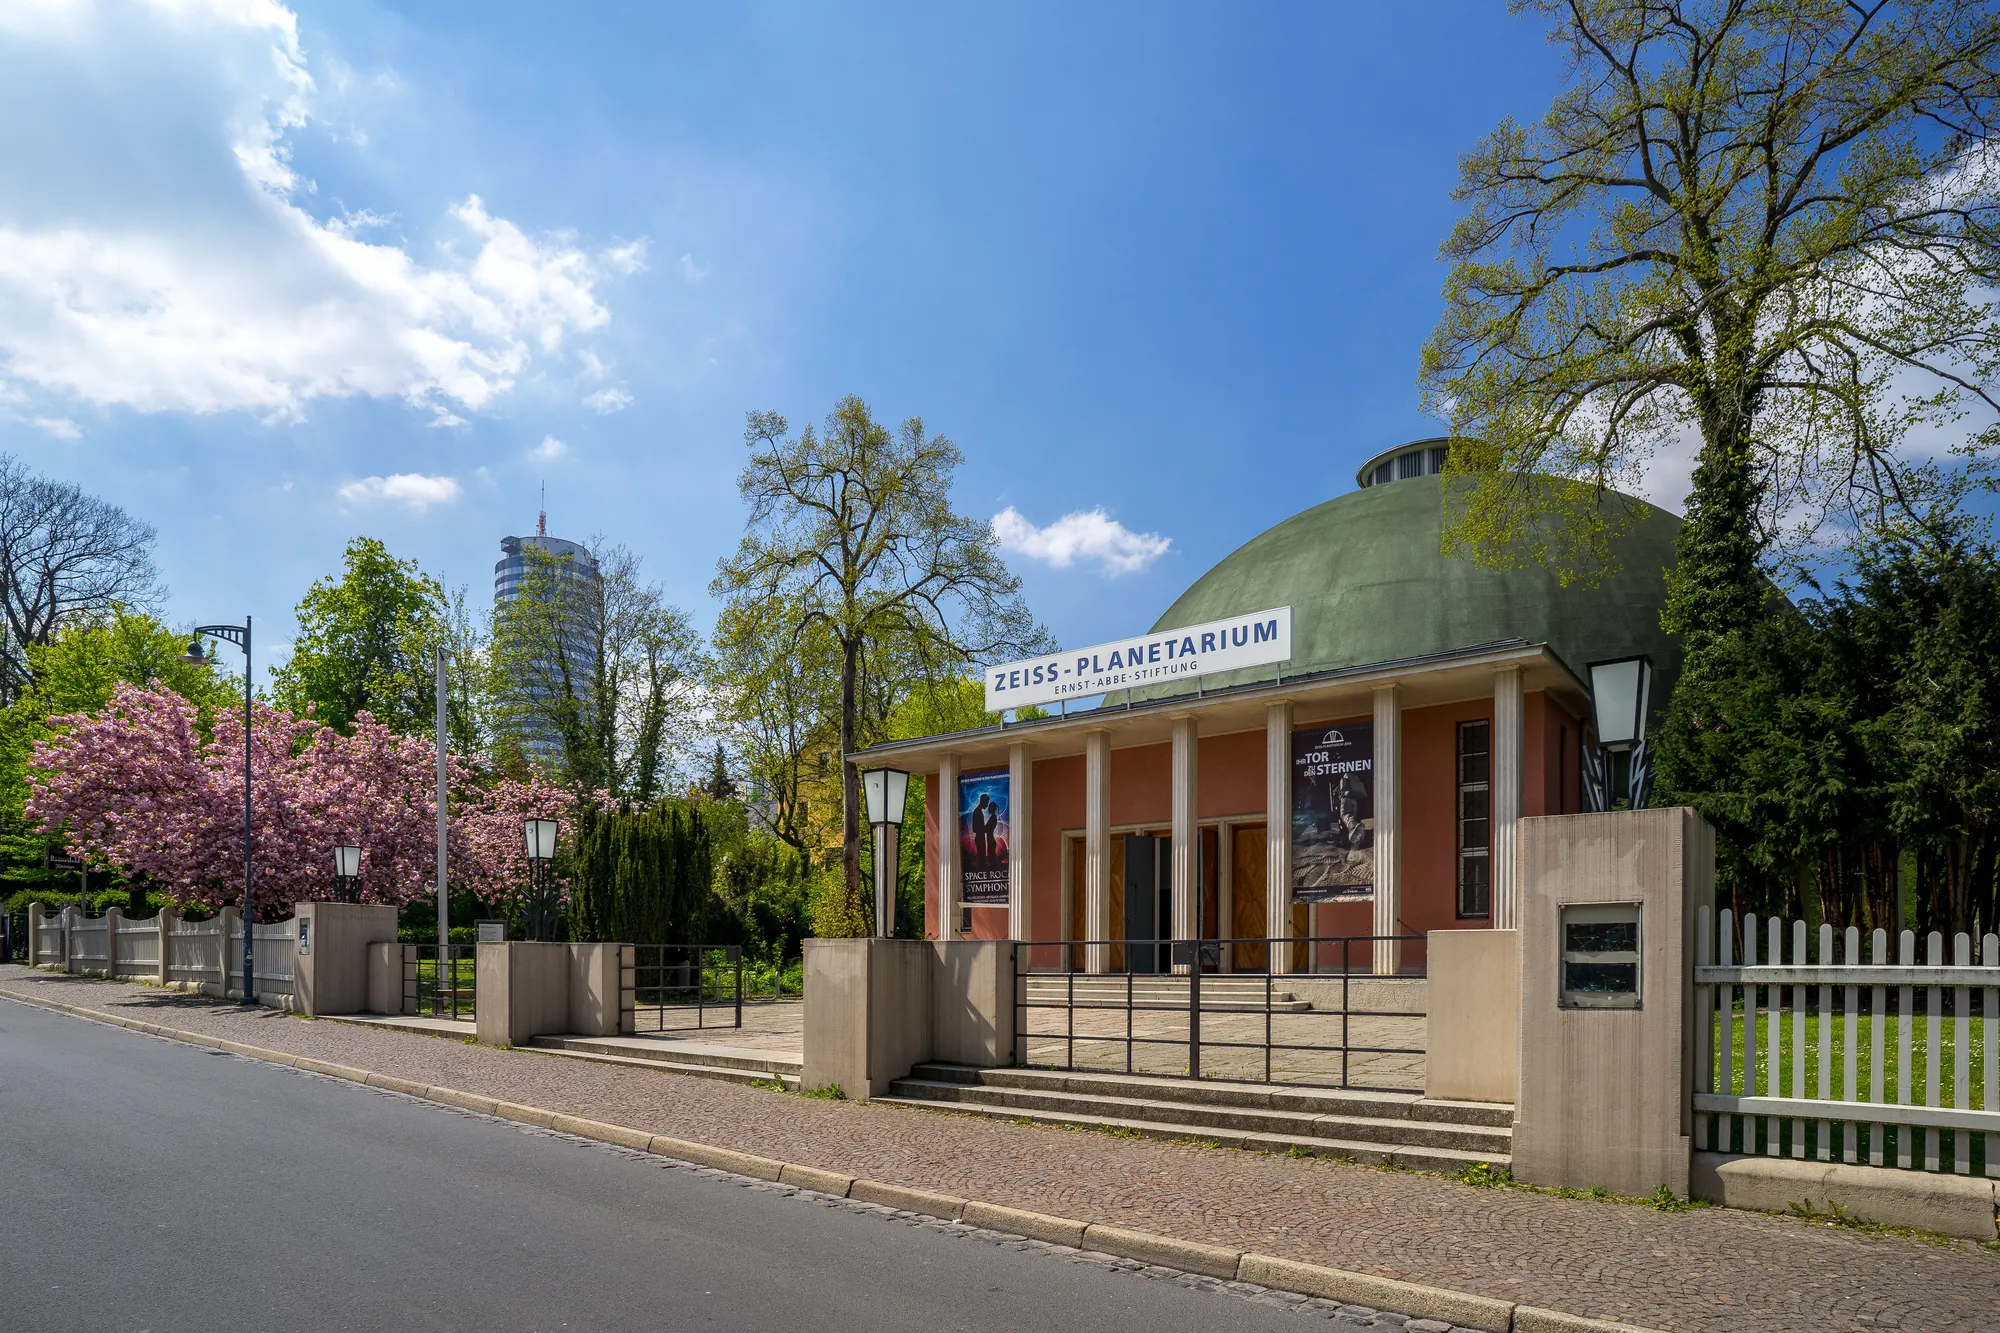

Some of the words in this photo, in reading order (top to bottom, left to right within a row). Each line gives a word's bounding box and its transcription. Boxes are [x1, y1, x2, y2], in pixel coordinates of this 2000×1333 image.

[1055, 660, 1198, 695] ERNST-ABBE-STIFTUNG
[1305, 751, 1329, 764] TOR
[1316, 759, 1371, 776] STERNEN
[964, 871, 988, 881] SPACE
[989, 870, 1009, 879] ROC
[965, 882, 1009, 893] SYMPHON
